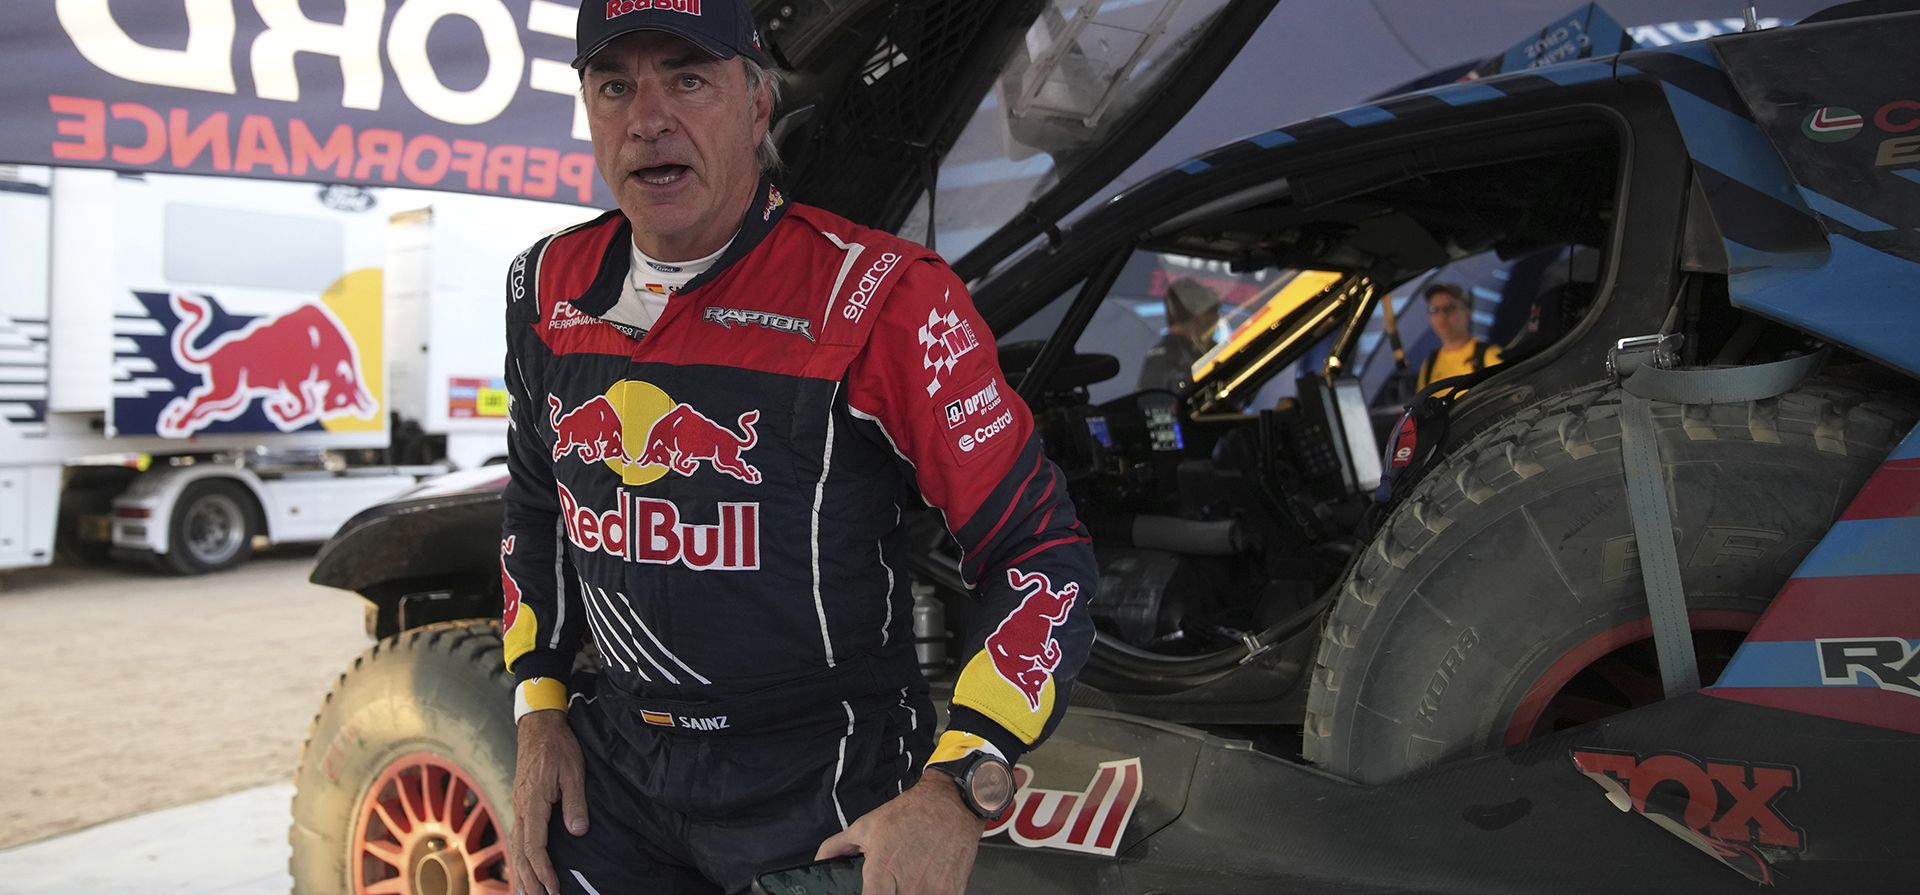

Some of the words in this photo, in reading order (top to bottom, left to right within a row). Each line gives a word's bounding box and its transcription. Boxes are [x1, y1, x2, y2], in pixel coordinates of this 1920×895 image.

[606, 0, 652, 20] Red
[654, 0, 701, 16] Bull
[511, 246, 534, 303] parco
[843, 252, 902, 323] sparco
[552, 301, 582, 320] FO
[703, 307, 816, 343] RAPTOR
[974, 408, 1013, 443] Castrol
[557, 487, 631, 562] Red
[636, 497, 760, 571] Bull
[679, 716, 730, 730] SAINZ
